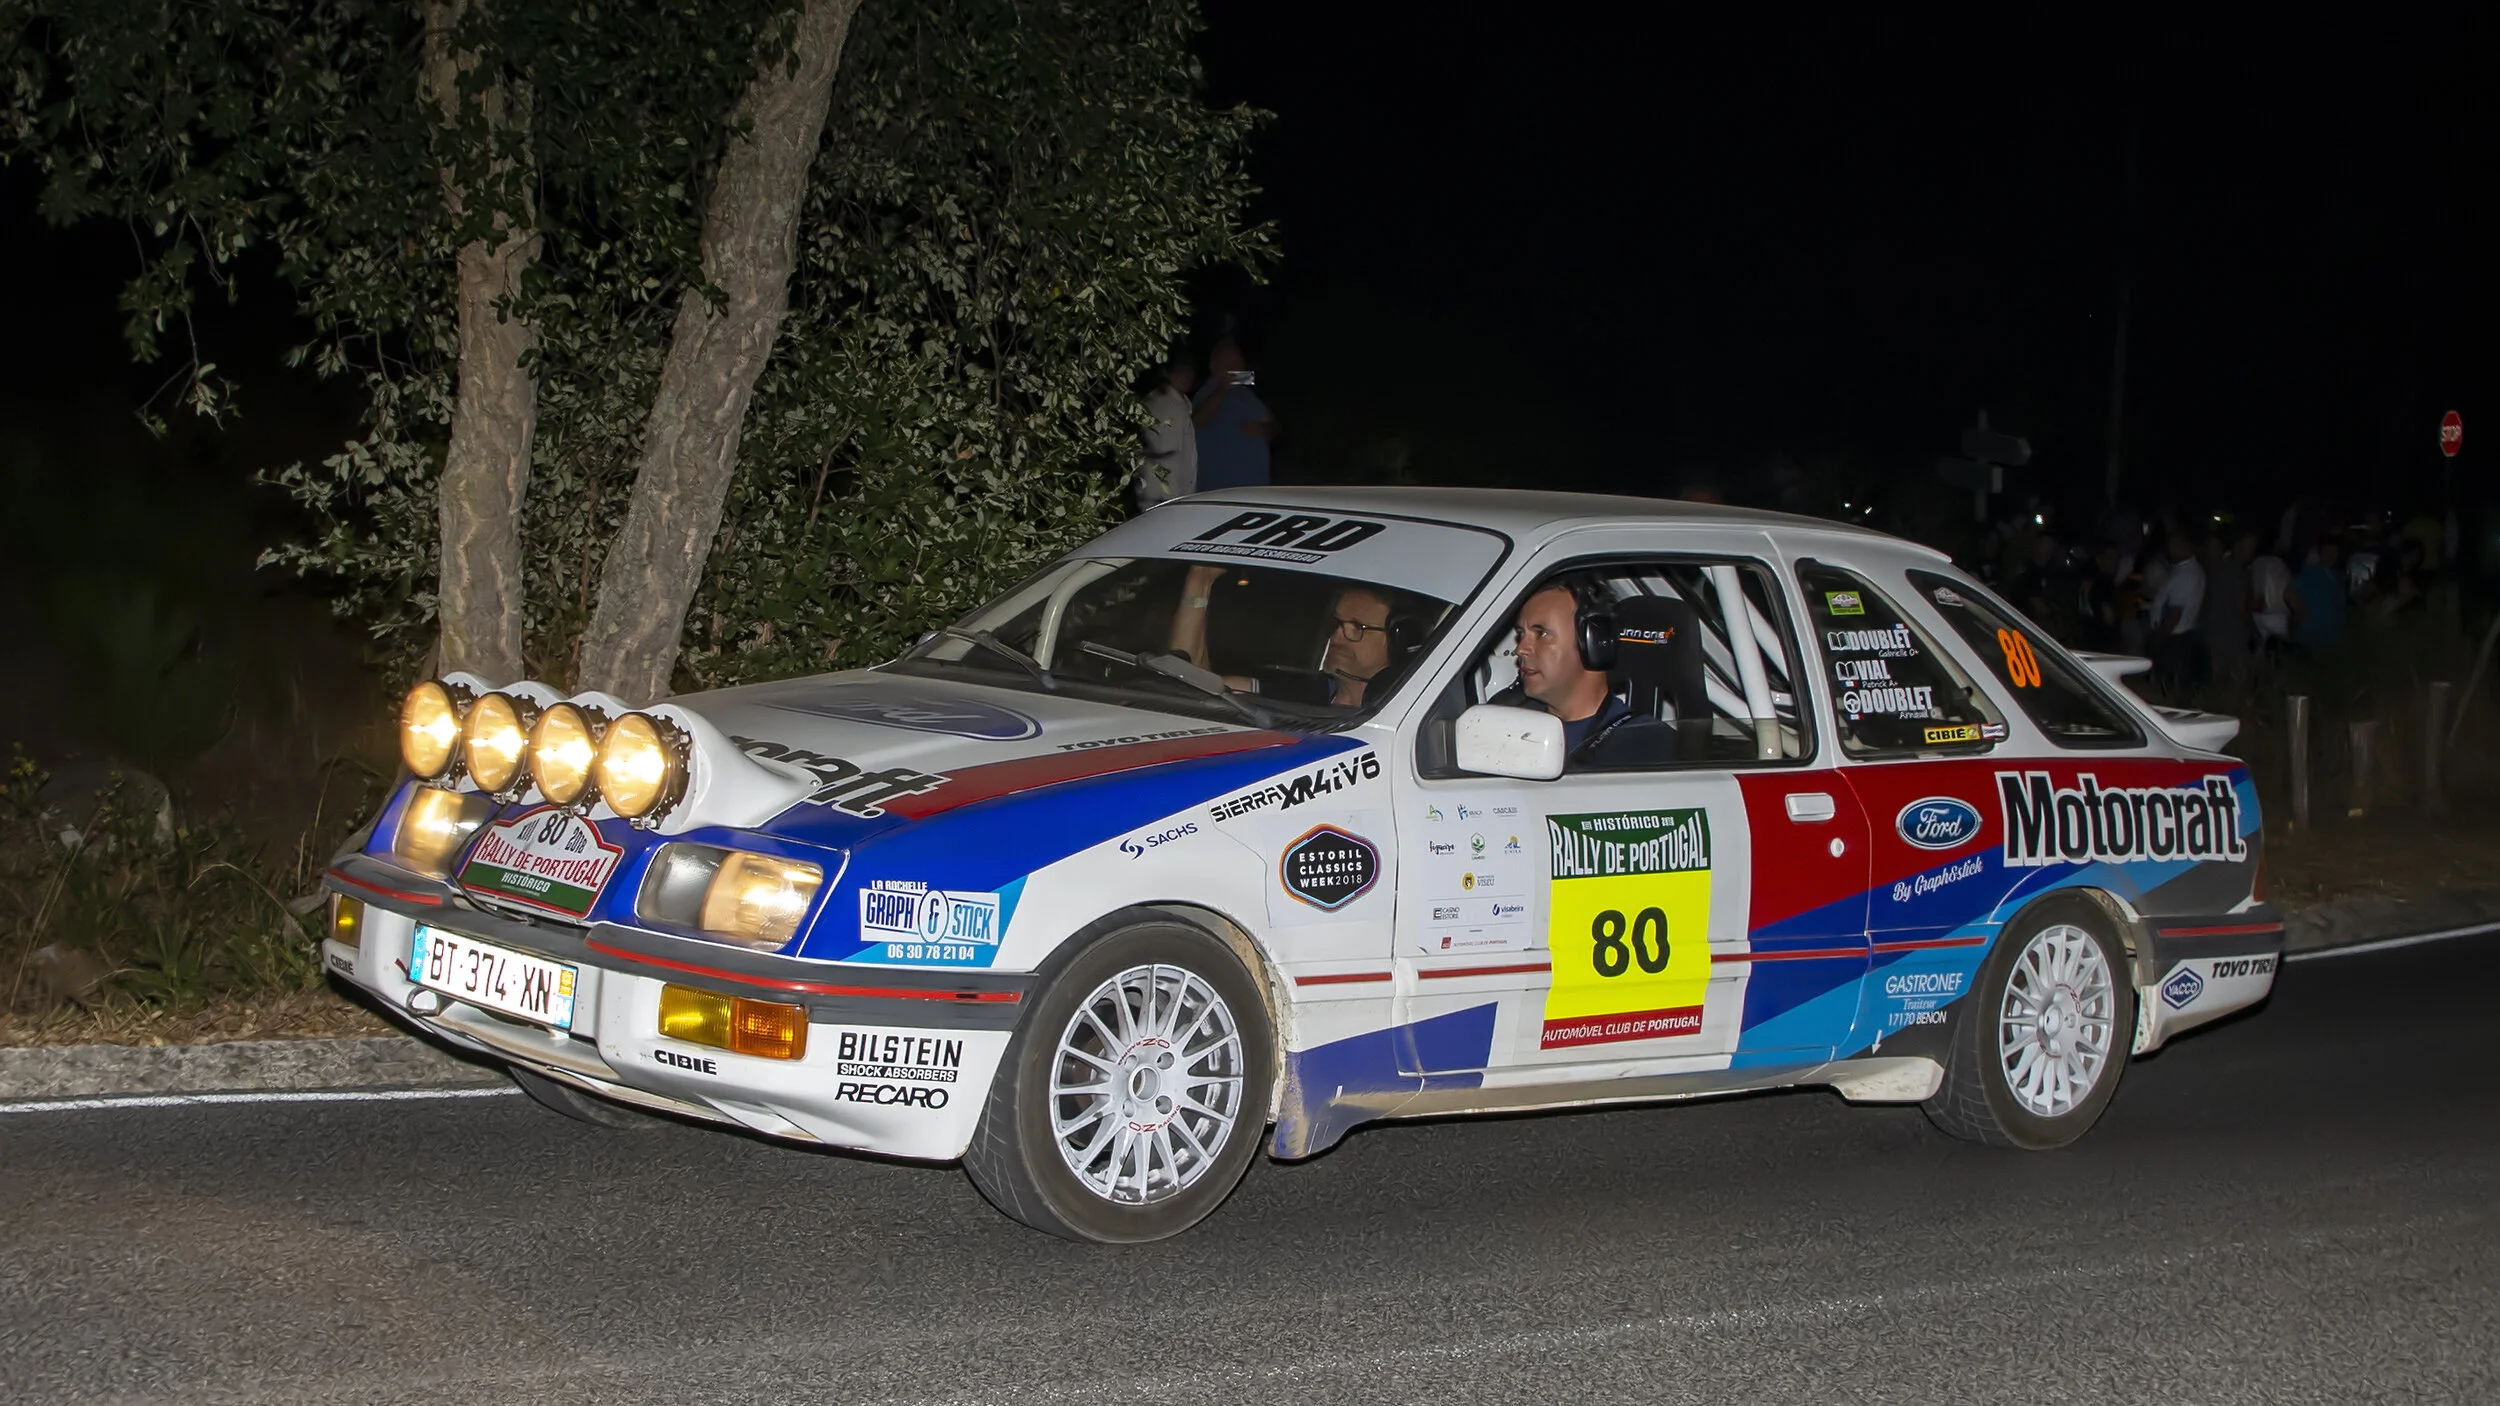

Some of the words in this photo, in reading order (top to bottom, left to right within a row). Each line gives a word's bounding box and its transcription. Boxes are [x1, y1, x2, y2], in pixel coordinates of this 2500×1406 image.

[1192, 511, 1387, 553] PRD
[1849, 628, 1911, 650] DOUBLET
[1859, 660, 1890, 680] VIAL
[1997, 628, 2042, 689] 80
[1862, 680, 1888, 689] Patrick
[1860, 686, 1933, 714] DOUBLET
[1057, 735, 1141, 751] TOYO
[1141, 726, 1229, 741] TIRES
[537, 812, 570, 846] 80
[1592, 813, 1660, 833] HISTÓRICO
[1916, 807, 1962, 840] Ford
[564, 825, 588, 854] 2018
[1145, 822, 1198, 849] SACHS
[1549, 817, 1603, 877] RALLY
[1604, 840, 1626, 875] DE
[1628, 810, 1708, 873] PORTUGAL
[476, 831, 513, 871] RALLY
[512, 850, 534, 871] DE
[530, 856, 609, 888] PORTUGAL
[1299, 848, 1362, 863] ESTORIL
[1299, 861, 1363, 876] CLASSICS
[501, 871, 552, 893] HISTÓRICO
[871, 879, 884, 891] LA
[884, 880, 928, 892] ROCHELLE
[1892, 881, 1912, 903] By
[866, 892, 915, 929] GRAPH
[952, 903, 994, 941] STICK
[887, 943, 904, 959] 06
[906, 944, 923, 960] 30
[925, 945, 941, 960] 78
[943, 945, 957, 961] 21
[958, 946, 975, 961] 04
[1591, 906, 1671, 978] 80
[430, 937, 458, 985] BT
[465, 948, 506, 1001] 374
[520, 963, 552, 1015] XN
[2211, 960, 2249, 979] TOYO
[1885, 972, 1964, 995] GASTRONEF
[2168, 981, 2199, 997] YACCO
[1902, 998, 1937, 1011] Traiteur
[1542, 1022, 1604, 1042] AUTOMÓVEL
[1605, 1019, 1631, 1036] CLUB
[1632, 1018, 1647, 1033] DE
[1647, 1015, 1701, 1032] PORTUGAL
[1887, 1011, 1916, 1027] 17170
[1916, 1010, 1948, 1026] BENON
[837, 1031, 964, 1068] BILSTEIN
[840, 1063, 884, 1079] SHOCK
[883, 1065, 956, 1083] ABSORBERS
[834, 1081, 949, 1110] RECARO
